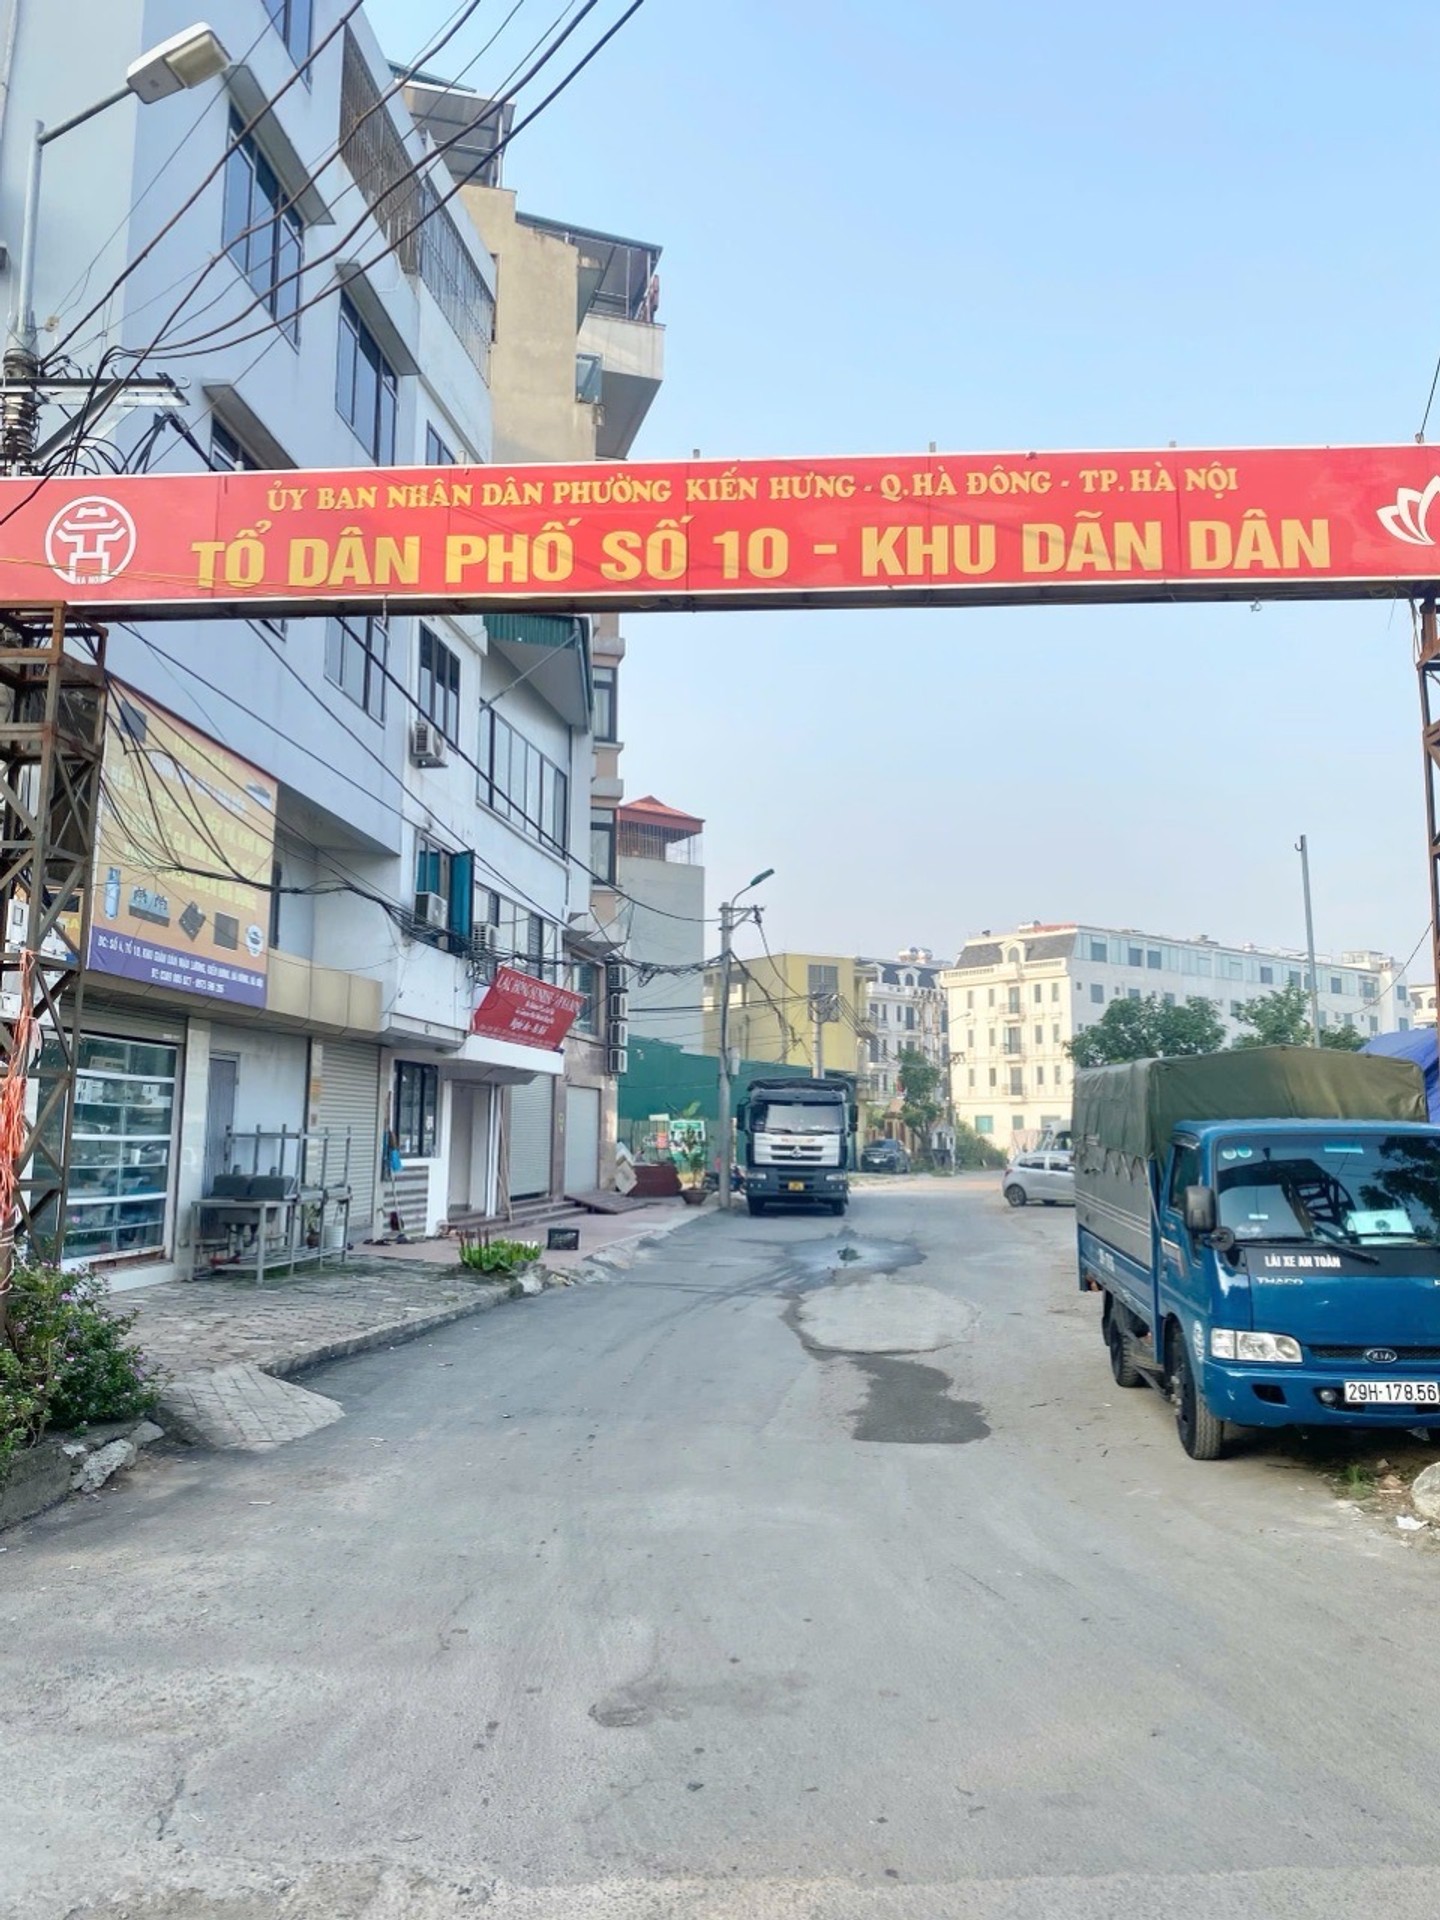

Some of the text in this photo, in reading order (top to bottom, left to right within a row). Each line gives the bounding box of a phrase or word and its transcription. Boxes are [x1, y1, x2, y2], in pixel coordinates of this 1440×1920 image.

[266, 479, 305, 512] ỦY
[316, 486, 377, 510] BAN
[386, 477, 473, 508] NHÂN
[481, 475, 543, 507] DÂN
[552, 472, 672, 505] PHƯỜNG
[685, 467, 759, 502] KIẾN
[769, 472, 856, 500] HƯNG
[966, 463, 1052, 495] ĐÔNG
[1184, 462, 1238, 500] NỘI
[190, 507, 1331, 590] TỔ DÂN PHỐ SỐ 10 - KHU DÃN DÂN
[1264, 1253, 1341, 1268] LÁI XE AN TOÀN
[1348, 1383, 1437, 1401] 29H-178.56
